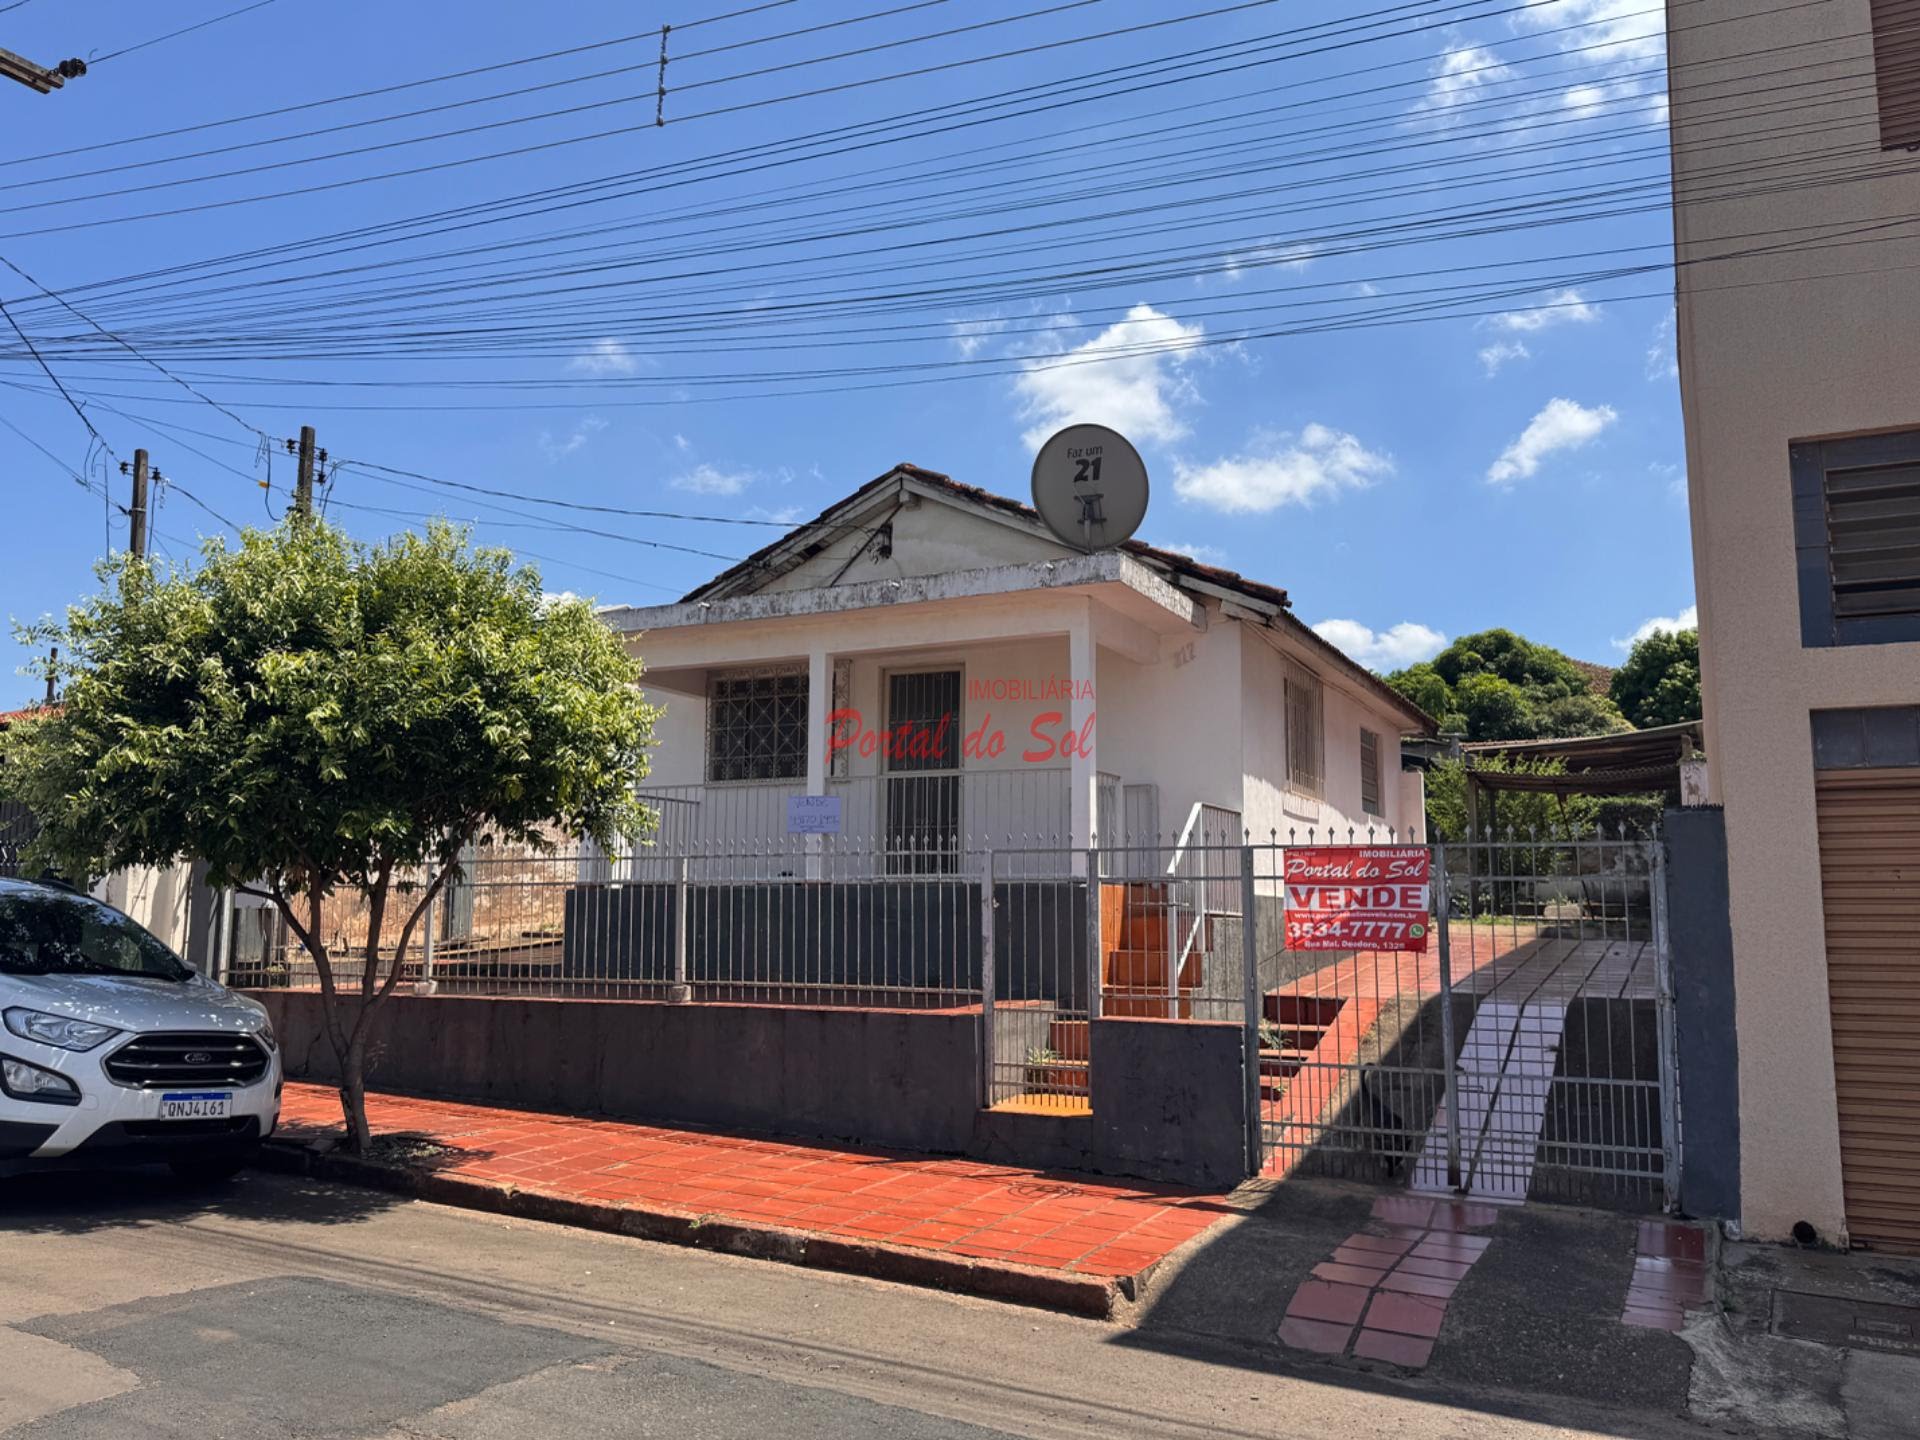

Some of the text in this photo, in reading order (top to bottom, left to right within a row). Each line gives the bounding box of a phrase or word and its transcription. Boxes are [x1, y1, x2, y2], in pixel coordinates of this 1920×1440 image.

[1067, 446, 1103, 459] Faz um
[1073, 457, 1102, 483] 21
[1286, 859, 1425, 880] Portal do Sol
[1290, 887, 1422, 908] VENDE
[1288, 921, 1406, 939] 3534-7777
[1304, 940, 1321, 948] Rua
[1341, 941, 1380, 950] Deodoro,
